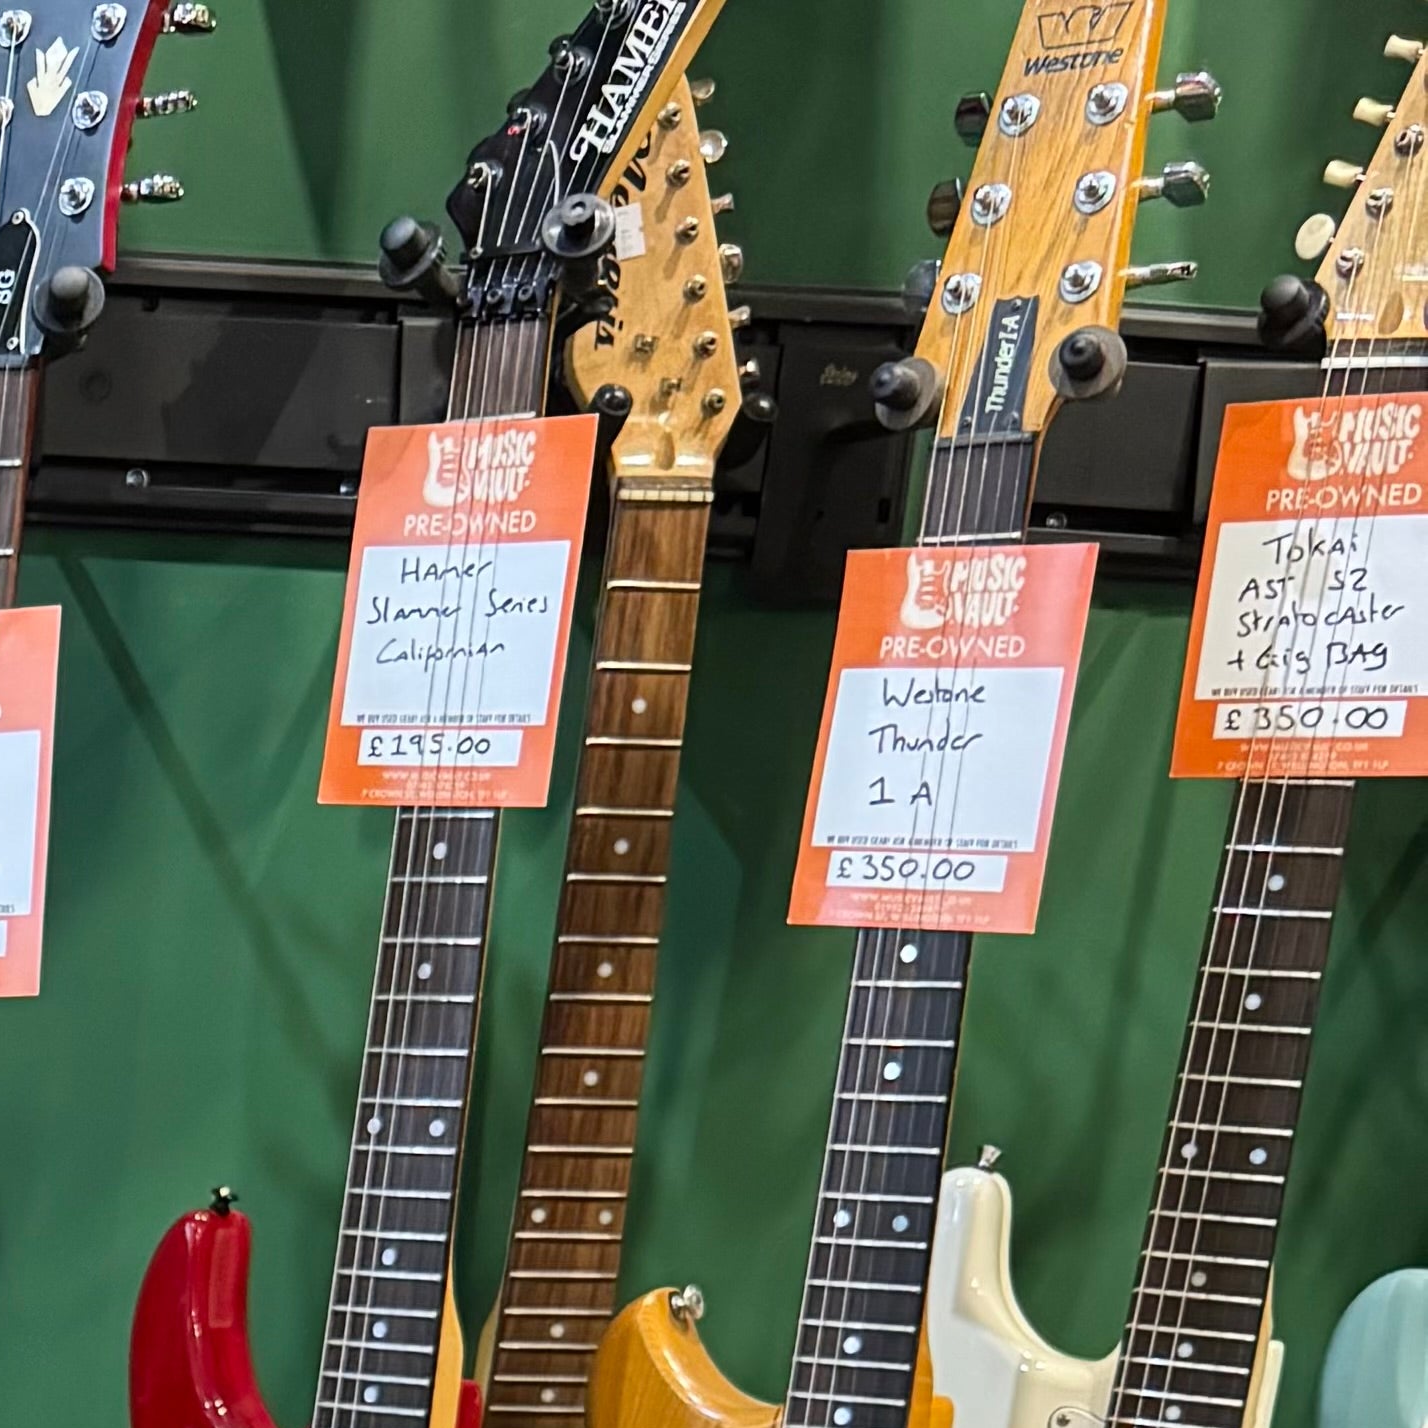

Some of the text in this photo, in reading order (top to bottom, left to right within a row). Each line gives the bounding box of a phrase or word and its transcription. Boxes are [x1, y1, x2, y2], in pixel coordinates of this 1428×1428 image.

[1023, 46, 1124, 77] Westone
[569, 0, 677, 161] HAME
[1338, 401, 1422, 443] MUSIC
[467, 428, 536, 468] MUSIC
[1341, 438, 1413, 478] VAULT
[1265, 482, 1423, 513] PRE-OWNED
[403, 510, 537, 537] PRE-OWNED
[1261, 527, 1358, 565] Tokai
[400, 557, 494, 584] Hamer
[950, 553, 1027, 593] MUSIC
[484, 592, 549, 618] Series
[950, 590, 1019, 629] VAULT
[1237, 592, 1406, 638] Stratocaster
[375, 638, 505, 672] Californian
[879, 634, 1026, 659] PRE-OWNED
[1227, 652, 1244, 672] +
[1256, 644, 1311, 675] Gig
[882, 676, 987, 707] Westone
[1223, 704, 1389, 731] £350.00
[367, 733, 491, 758] £195.00
[868, 718, 984, 753] Thunder
[868, 776, 933, 806] 1 A
[836, 854, 976, 882] £350.00
